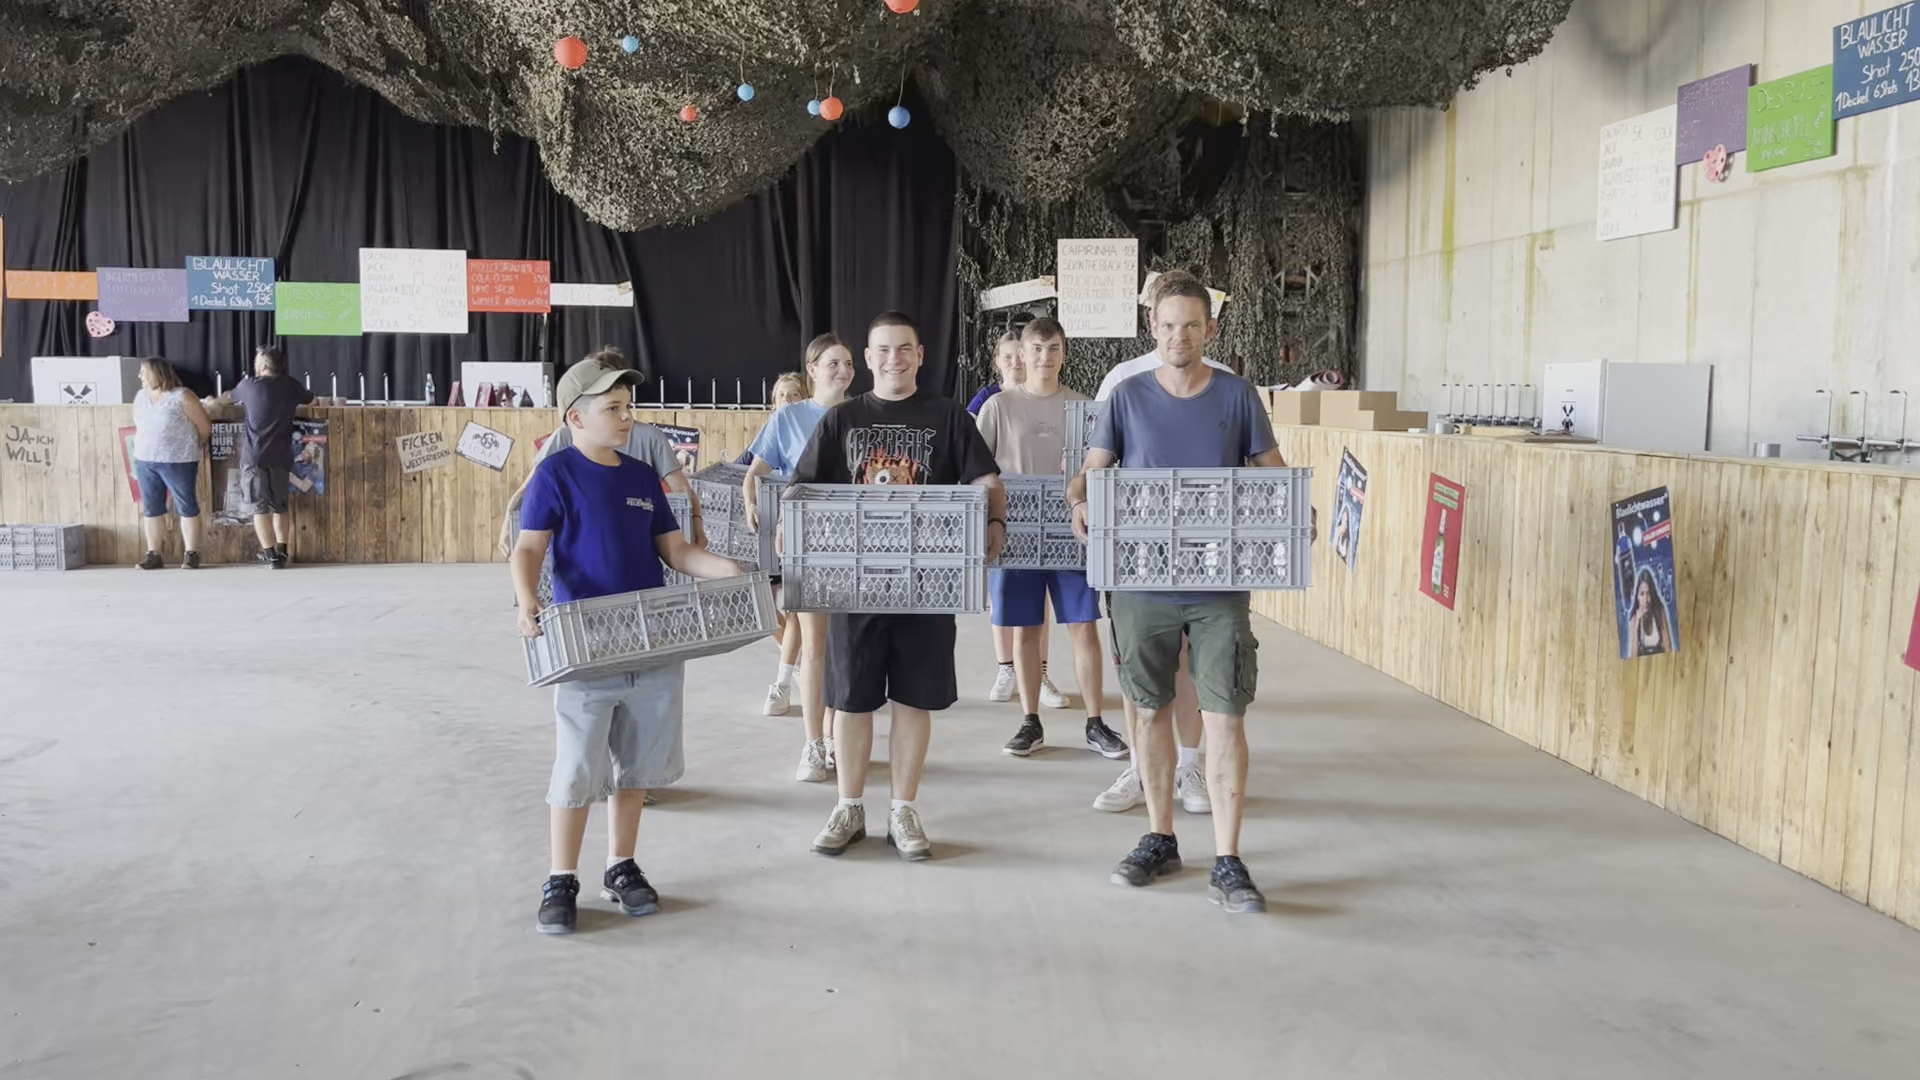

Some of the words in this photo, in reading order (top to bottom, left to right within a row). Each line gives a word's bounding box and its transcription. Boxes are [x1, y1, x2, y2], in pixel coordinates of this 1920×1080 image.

[1840, 3, 1915, 49] BLAULICHT
[1858, 29, 1907, 59] WASSER
[1861, 57, 1891, 84] Shot
[193, 257, 268, 273] BLAULICHT
[212, 271, 260, 281] WASSER
[211, 281, 240, 295] Shot
[211, 436, 233, 447] NUR
[402, 431, 443, 452] FICKEN
